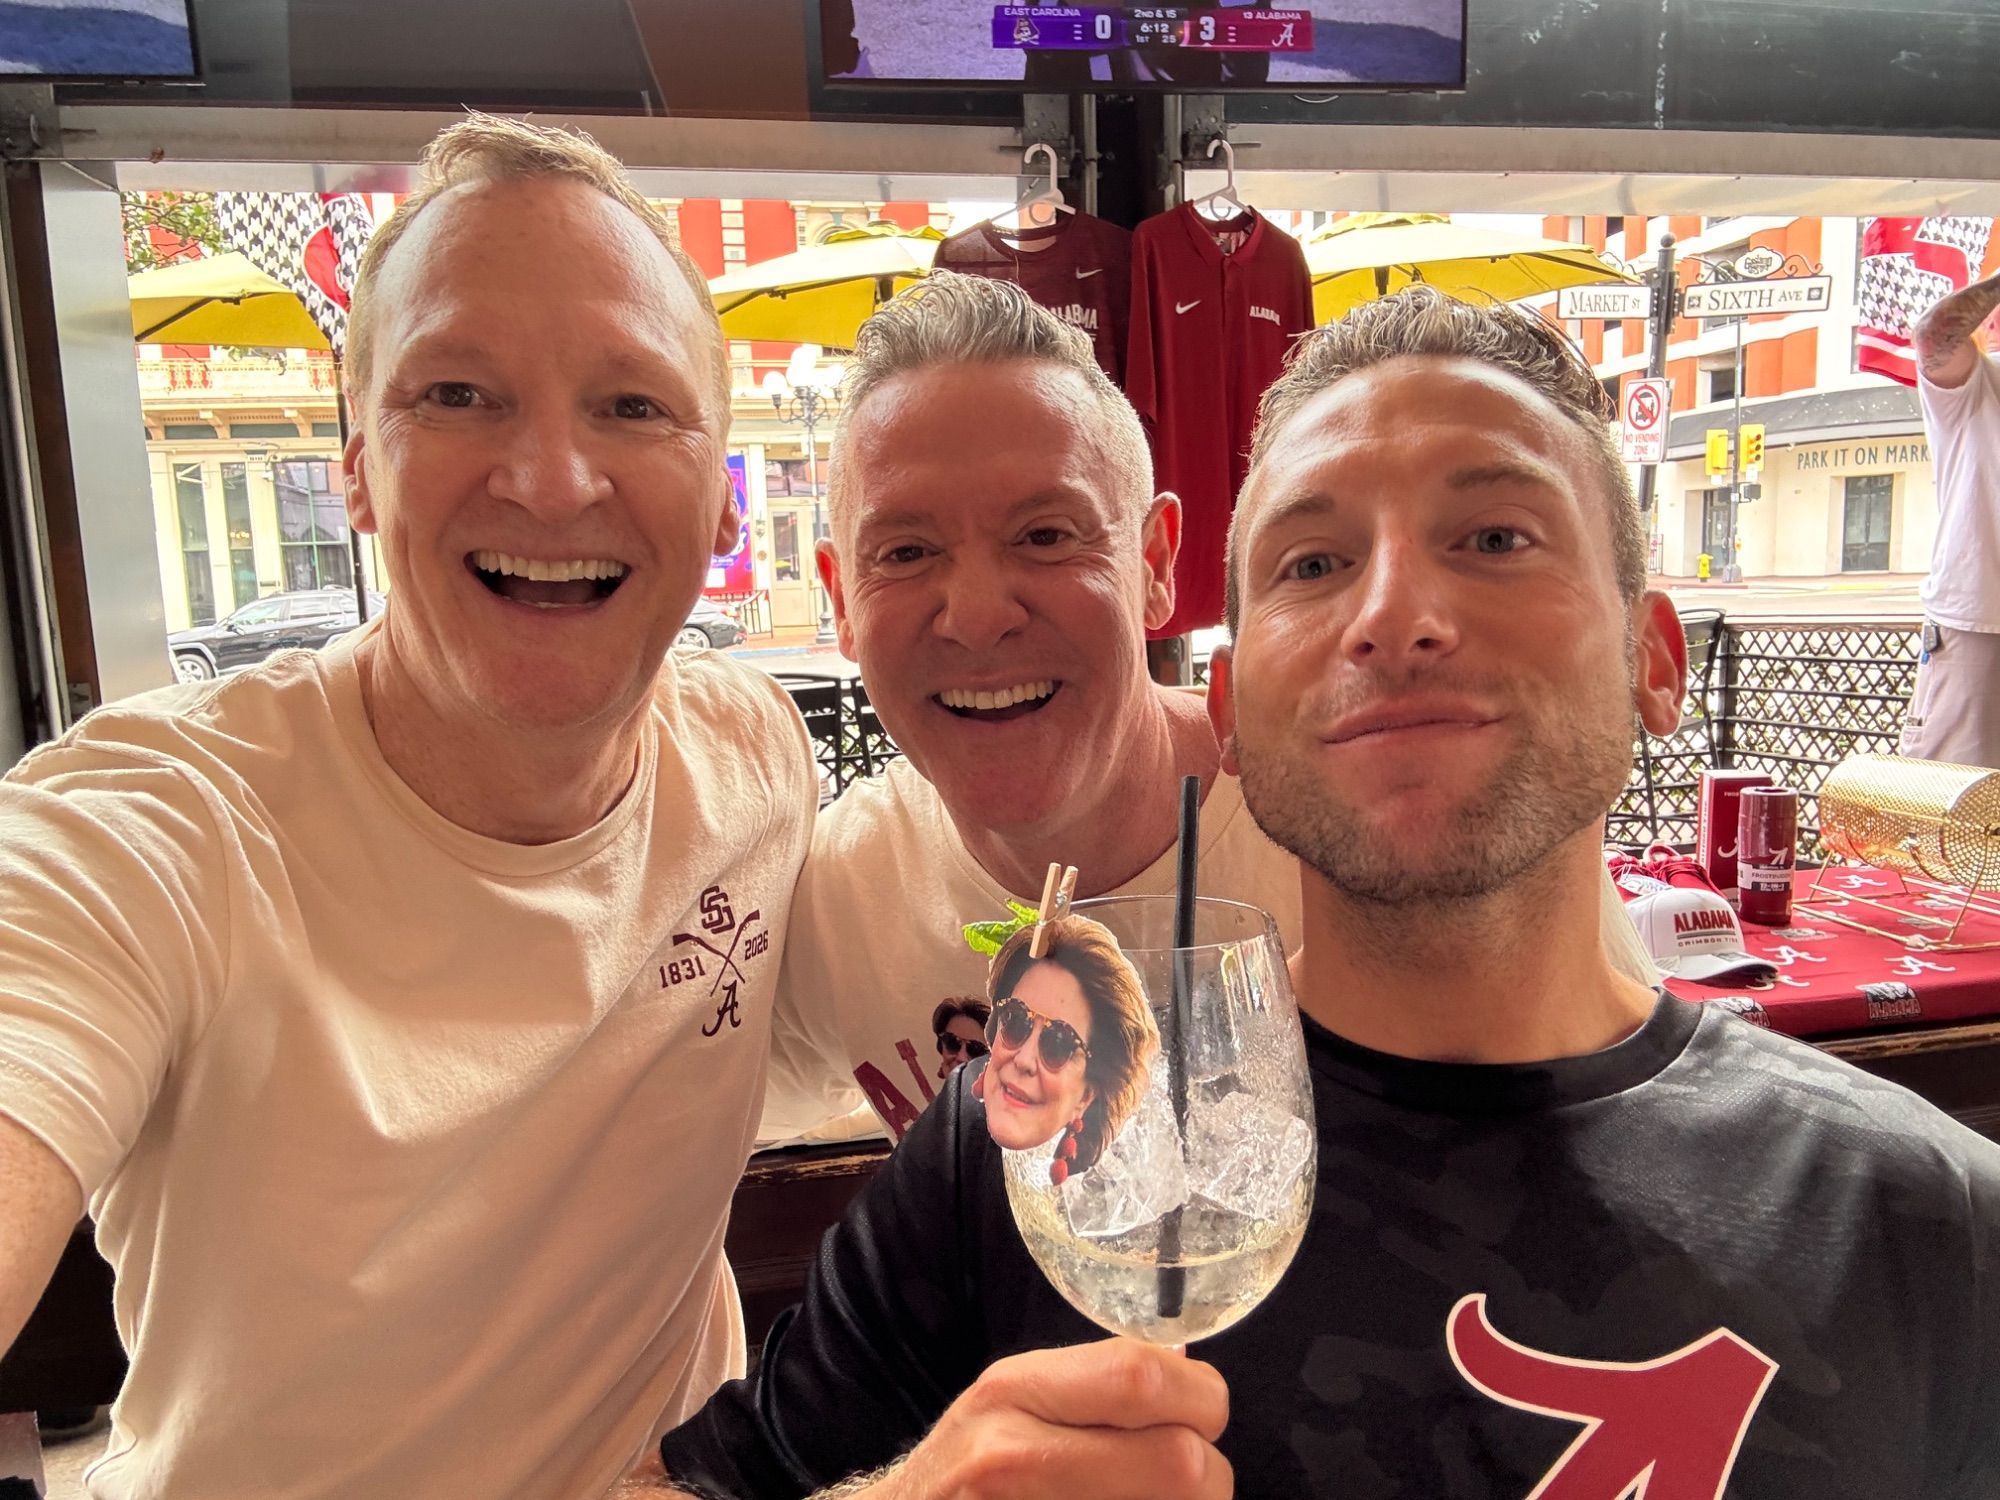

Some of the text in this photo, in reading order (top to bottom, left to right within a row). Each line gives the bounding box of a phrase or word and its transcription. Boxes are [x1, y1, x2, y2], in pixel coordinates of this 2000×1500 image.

[1004, 8, 1081, 17] EAST CAROLINA
[1134, 9, 1177, 18] 2ND & 15
[1255, 12, 1302, 20] ALABAMA
[1095, 14, 1112, 39] 0
[1140, 23, 1170, 33] 6:12
[1200, 16, 1215, 41] 3
[1162, 35, 1177, 44] 25
[1569, 291, 1629, 315] MARKET
[1707, 287, 1803, 311] SIXTH AVE
[1625, 433, 1660, 443] NO VENDING
[1633, 445, 1648, 455] ZONE
[1797, 444, 1931, 470] PARK IT ON MARK
[1674, 909, 1735, 933] ALABAMA
[1678, 938, 1722, 947] CRIMSON
[659, 930, 769, 988] 1831 2026
